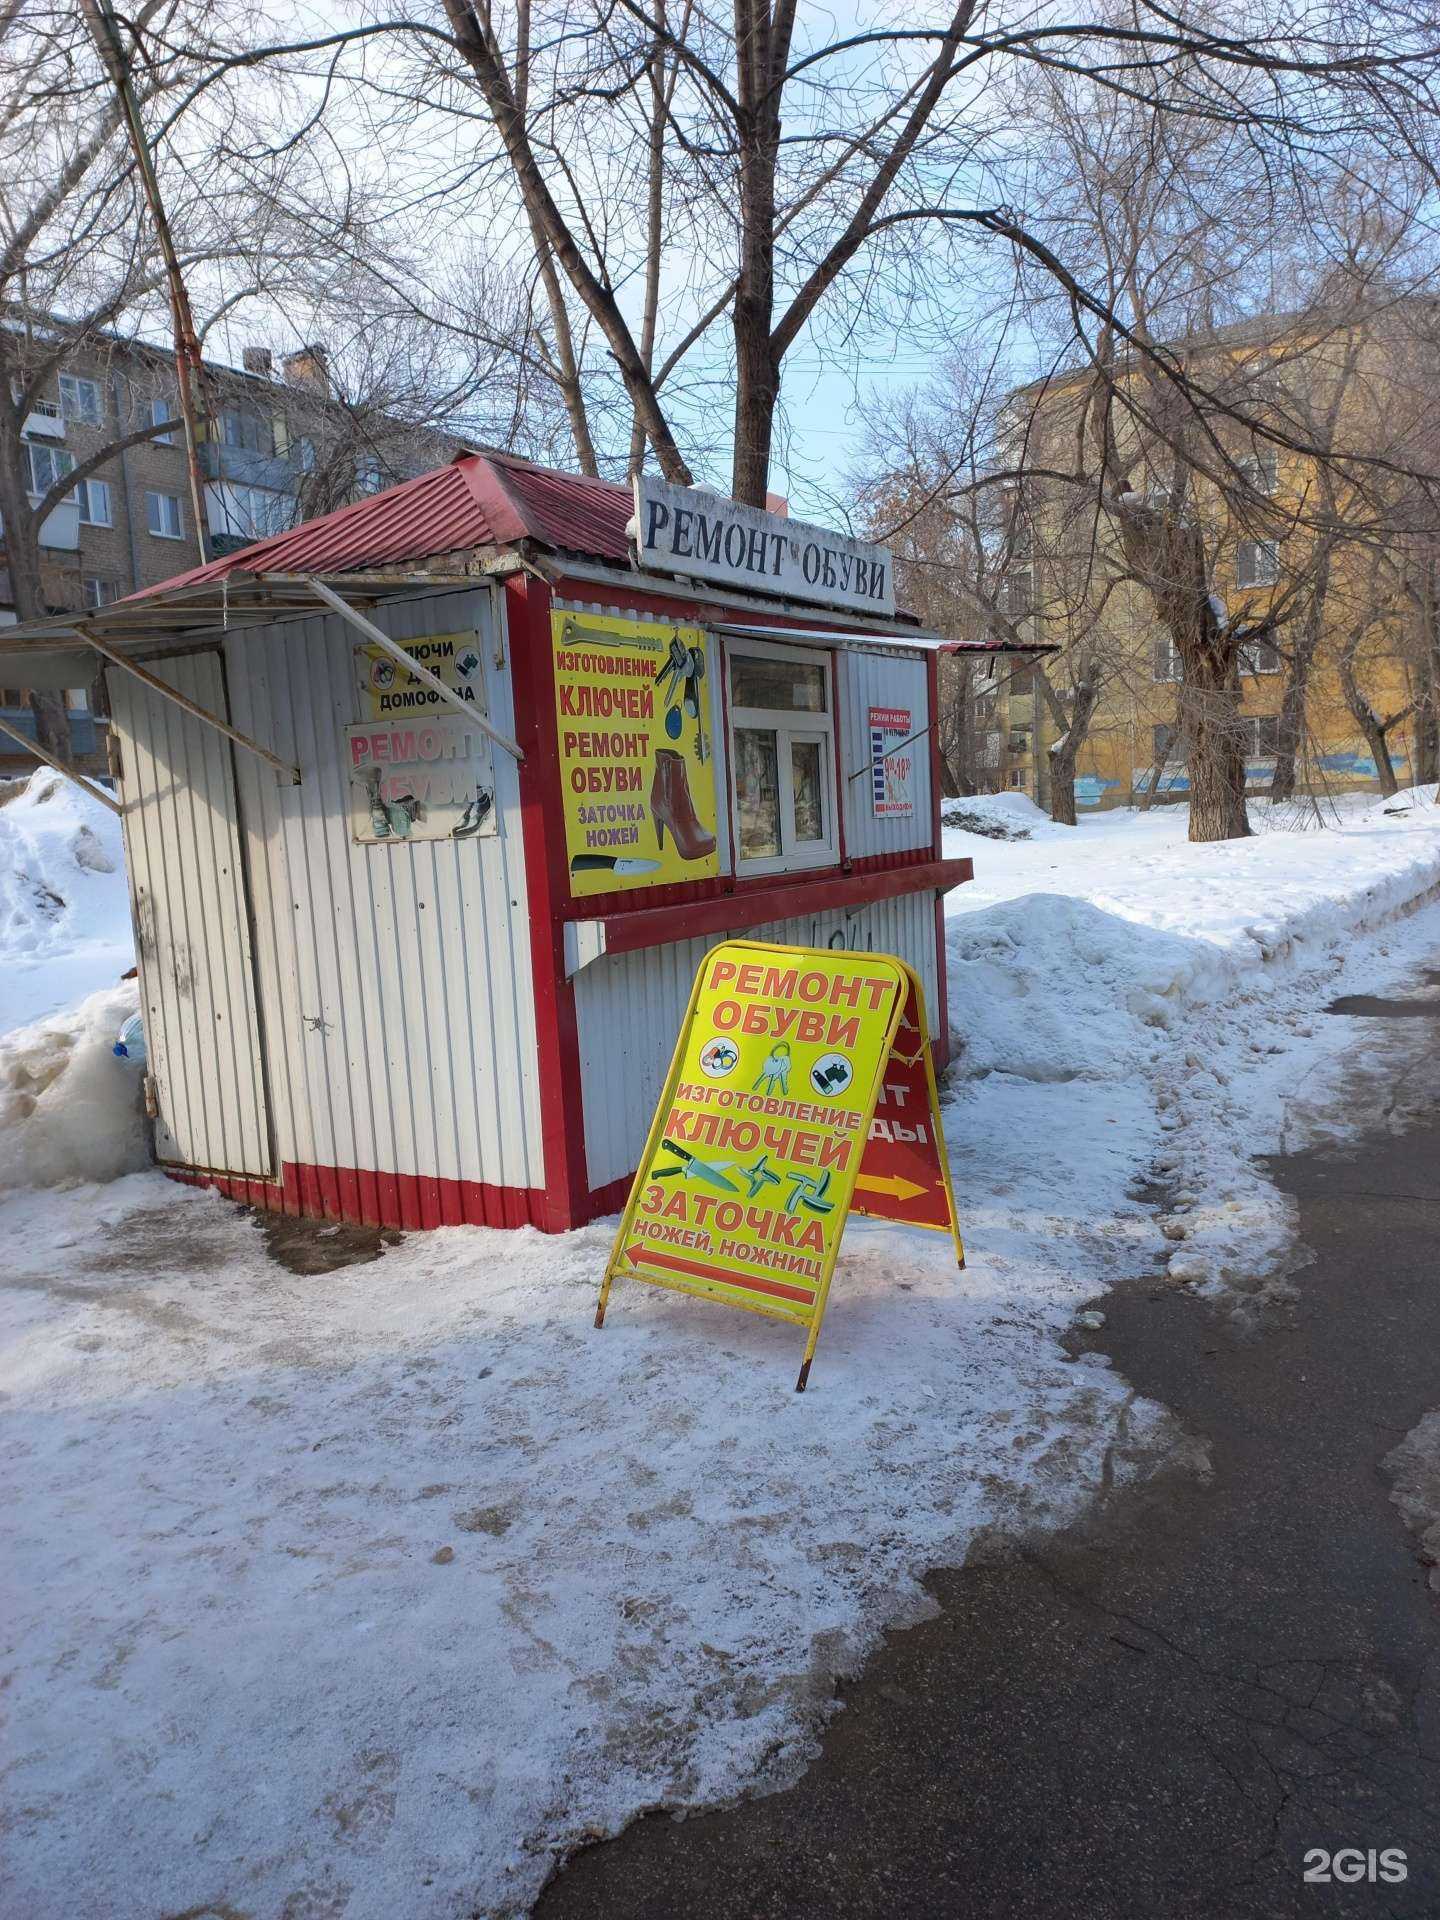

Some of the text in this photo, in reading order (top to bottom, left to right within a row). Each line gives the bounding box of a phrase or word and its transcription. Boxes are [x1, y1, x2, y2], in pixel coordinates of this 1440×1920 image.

[643, 500, 886, 601] РЕМОНТ ОБУВИ
[394, 641, 454, 663] ЛЮЧИ
[556, 650, 658, 678] ИЗГОТОВЛЕНИЕ
[407, 665, 441, 686] ДЯ
[380, 685, 476, 712] ДОМОФНА
[559, 683, 654, 719] КЛЮЧЕЙ
[563, 731, 650, 758] РЕМОНТ
[570, 766, 643, 793] ОБУВИ
[577, 803, 646, 824] ЗАТОЧКА
[586, 823, 640, 847] НОЖЕЙ
[709, 961, 894, 1011] РЕМОНТ
[712, 1000, 860, 1049] ОБУВИ
[676, 1082, 865, 1131] ИЗГОТОВЛЕНИЕ
[664, 1108, 855, 1172] КЛЮЧЕЙ
[641, 1185, 825, 1254] ЗАТОЧКА
[633, 1218, 823, 1282] НОЖЕЙ, НОЖНИЦ
